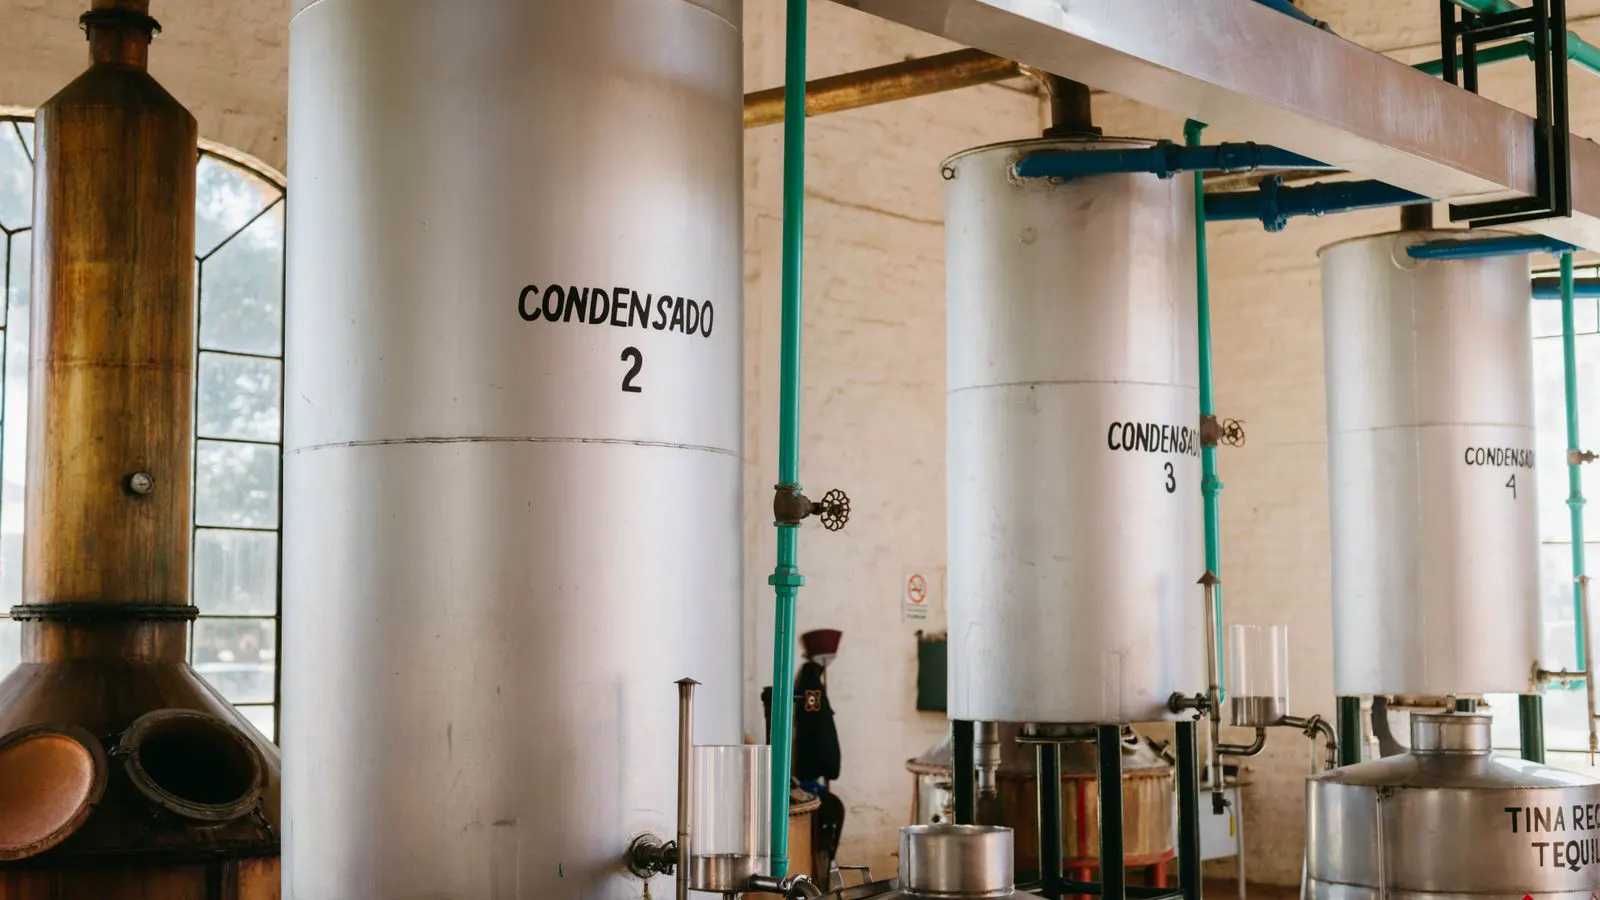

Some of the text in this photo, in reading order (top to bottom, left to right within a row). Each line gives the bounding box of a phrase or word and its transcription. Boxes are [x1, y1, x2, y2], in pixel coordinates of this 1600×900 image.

[518, 284, 714, 338] CONDENSADO
[620, 346, 643, 393] 2
[1164, 461, 1176, 493] 3
[1505, 473, 1516, 499] 4
[1504, 806, 1565, 833] TINA
[1531, 838, 1600, 872] TEQUIL
